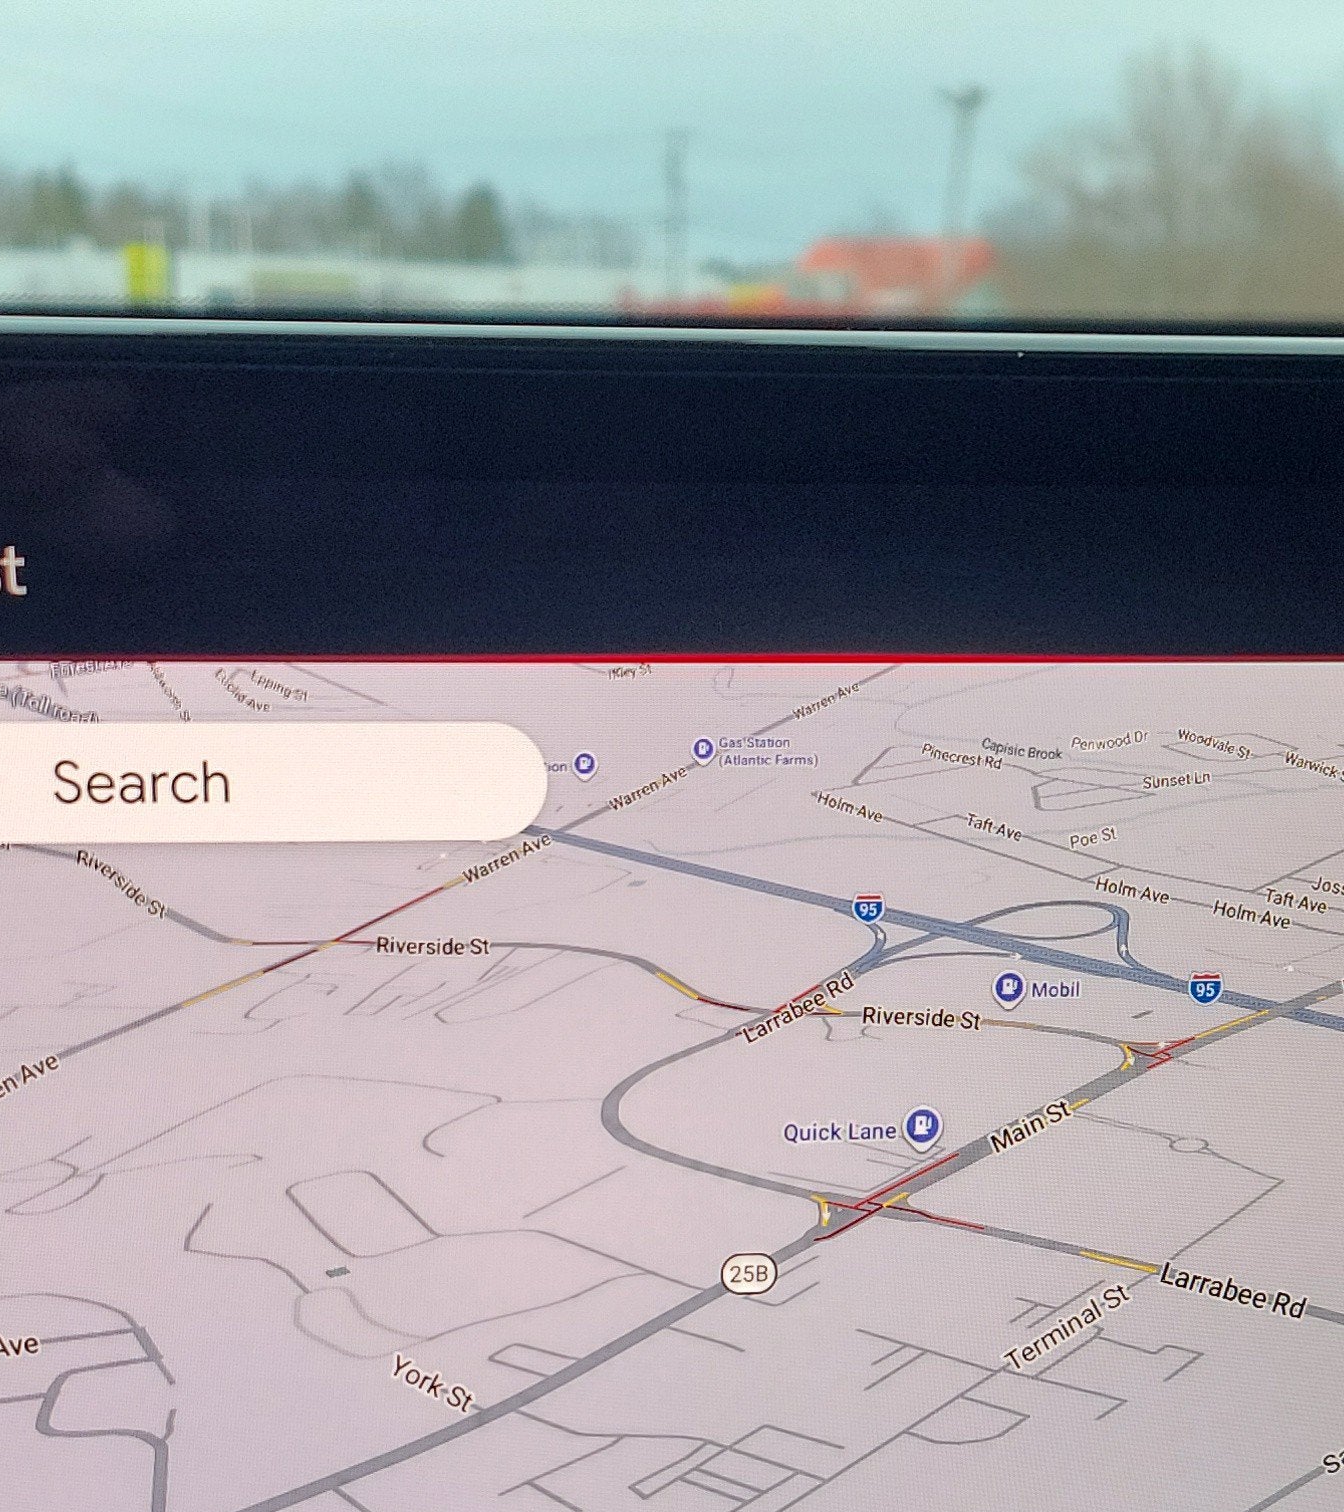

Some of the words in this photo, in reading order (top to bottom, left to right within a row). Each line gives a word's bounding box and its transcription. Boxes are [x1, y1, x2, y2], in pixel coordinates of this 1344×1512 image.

[792, 694, 835, 720] Warren
[838, 683, 859, 699] Ave
[719, 737, 741, 748] Gas
[746, 737, 790, 748] Station
[982, 737, 1024, 759] Capisic
[1028, 747, 1062, 760] Brook
[1071, 734, 1131, 749] Penwood
[1134, 731, 1149, 743] Dr
[1178, 729, 1234, 753] Woodvale
[1237, 746, 1251, 759] St
[718, 754, 770, 767] (Atlantic
[775, 754, 818, 767] Farms)
[922, 743, 982, 766] Pinecrest
[984, 756, 1002, 769] Rd
[1285, 752, 1337, 778] Warwick
[54, 760, 229, 804] Search
[609, 780, 659, 810] Warren
[661, 766, 687, 787] Ave
[1143, 776, 1191, 789] Sunset
[1194, 772, 1211, 784] Ln
[817, 791, 854, 815] Holm
[857, 806, 883, 822] Ave
[968, 813, 993, 833] Taft
[996, 824, 1022, 841] Ave
[1070, 832, 1097, 848] Poe
[1101, 826, 1117, 841] St
[463, 849, 520, 884] Warren
[522, 833, 552, 858] Ave
[77, 850, 146, 907] Riverside
[148, 899, 166, 919] St
[1096, 877, 1138, 898] Holm
[1140, 889, 1170, 904] Ave
[860, 904, 877, 917] 95
[1266, 888, 1295, 907] Taft
[1297, 897, 1327, 913] Ave
[1213, 900, 1257, 923] Holm
[1259, 913, 1291, 929] Ave
[376, 937, 465, 956] Riverside
[470, 938, 490, 956] St
[1032, 981, 1080, 998] Mobil
[1197, 981, 1215, 996] 95
[743, 992, 826, 1044] Larrabee
[826, 973, 854, 1002] Rd
[863, 1007, 955, 1028] Riverside
[961, 1012, 981, 1031] St
[20, 1056, 59, 1084] Ave
[784, 1123, 841, 1144] Quick
[849, 1123, 896, 1140] Lane
[990, 1116, 1045, 1154] Main
[1045, 1100, 1070, 1130] St
[730, 1264, 768, 1283] 25B
[1160, 1261, 1267, 1311] Larrabee
[1272, 1292, 1307, 1319] Rd
[1004, 1300, 1102, 1372] Terminal
[1099, 1283, 1131, 1316] St
[389, 1356, 443, 1399] York
[446, 1383, 474, 1412] St
